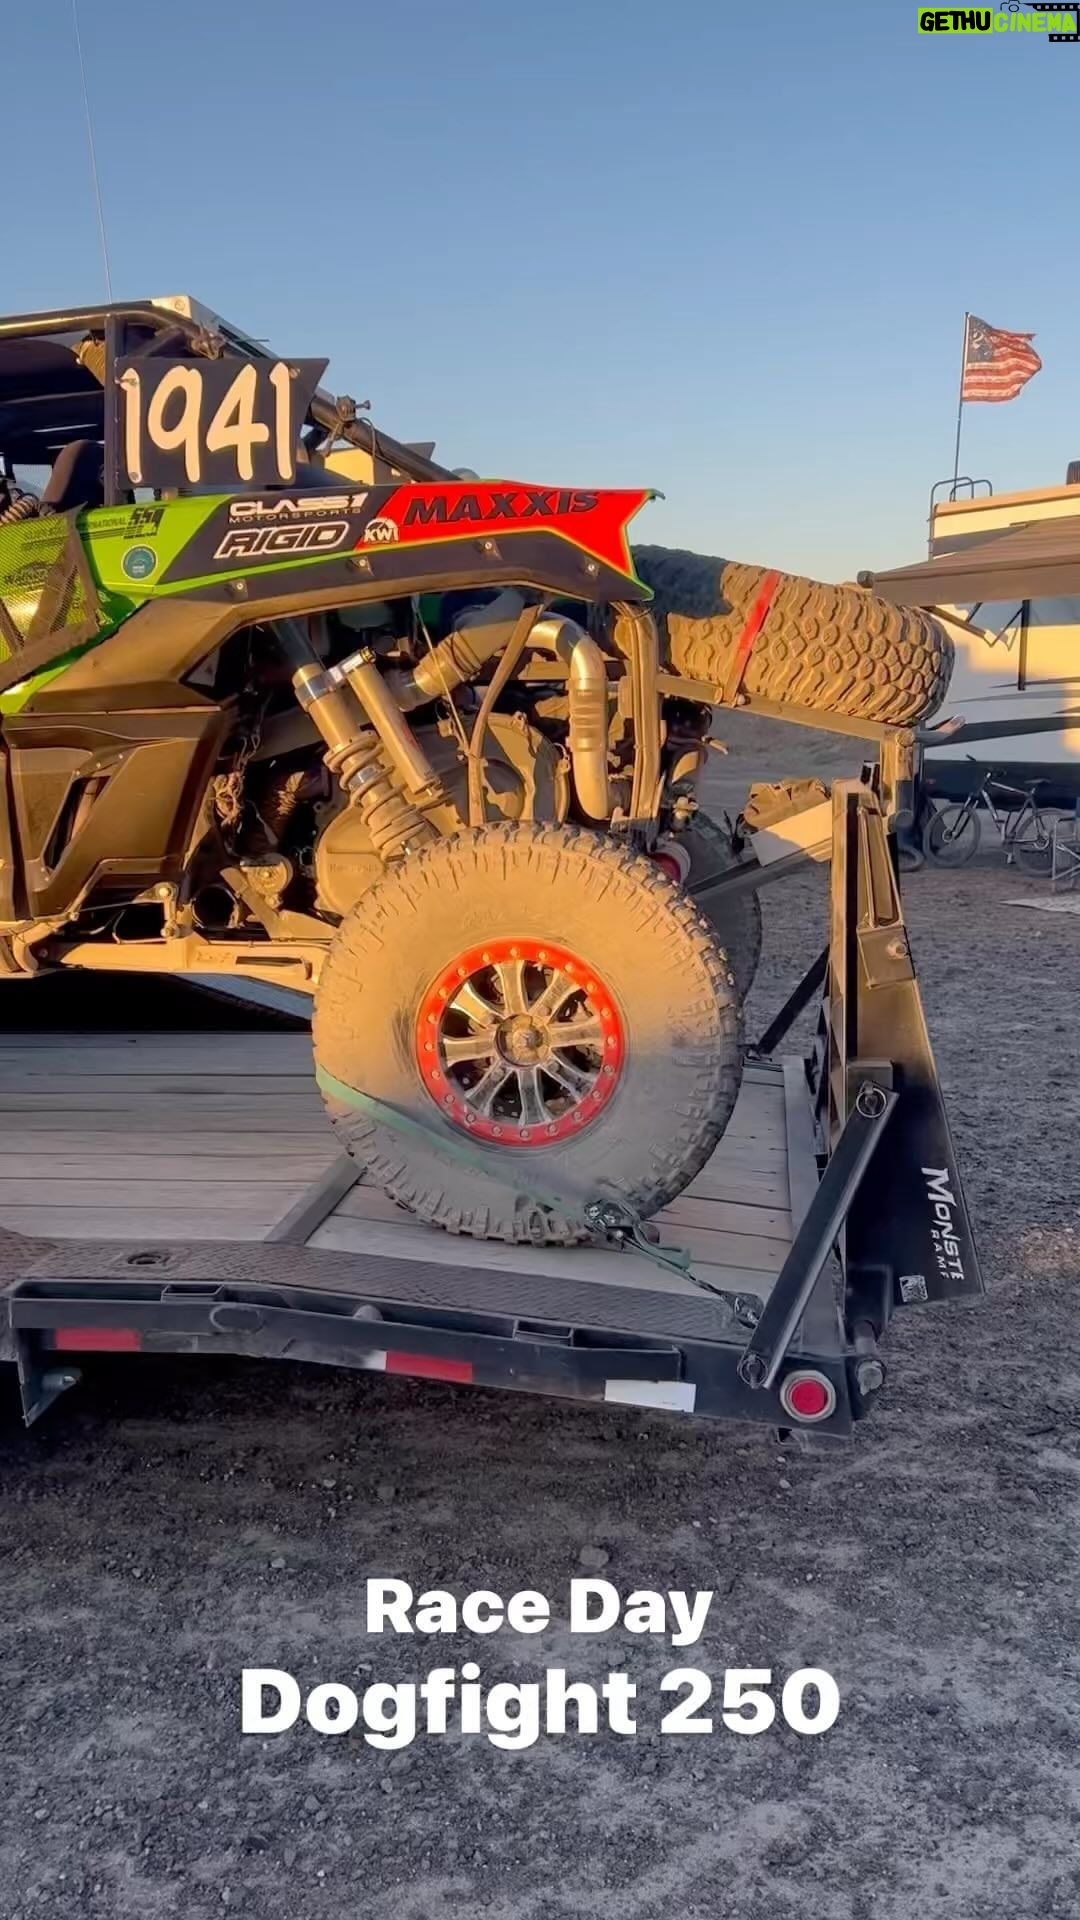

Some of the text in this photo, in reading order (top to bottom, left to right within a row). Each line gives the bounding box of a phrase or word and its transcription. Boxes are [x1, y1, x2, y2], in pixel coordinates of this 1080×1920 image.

[119, 361, 293, 484] 1941
[229, 492, 369, 516] CLASS1
[229, 508, 361, 524] MOTORSPORTS
[403, 490, 600, 526] MAXXIS
[213, 521, 350, 560] RIGID
